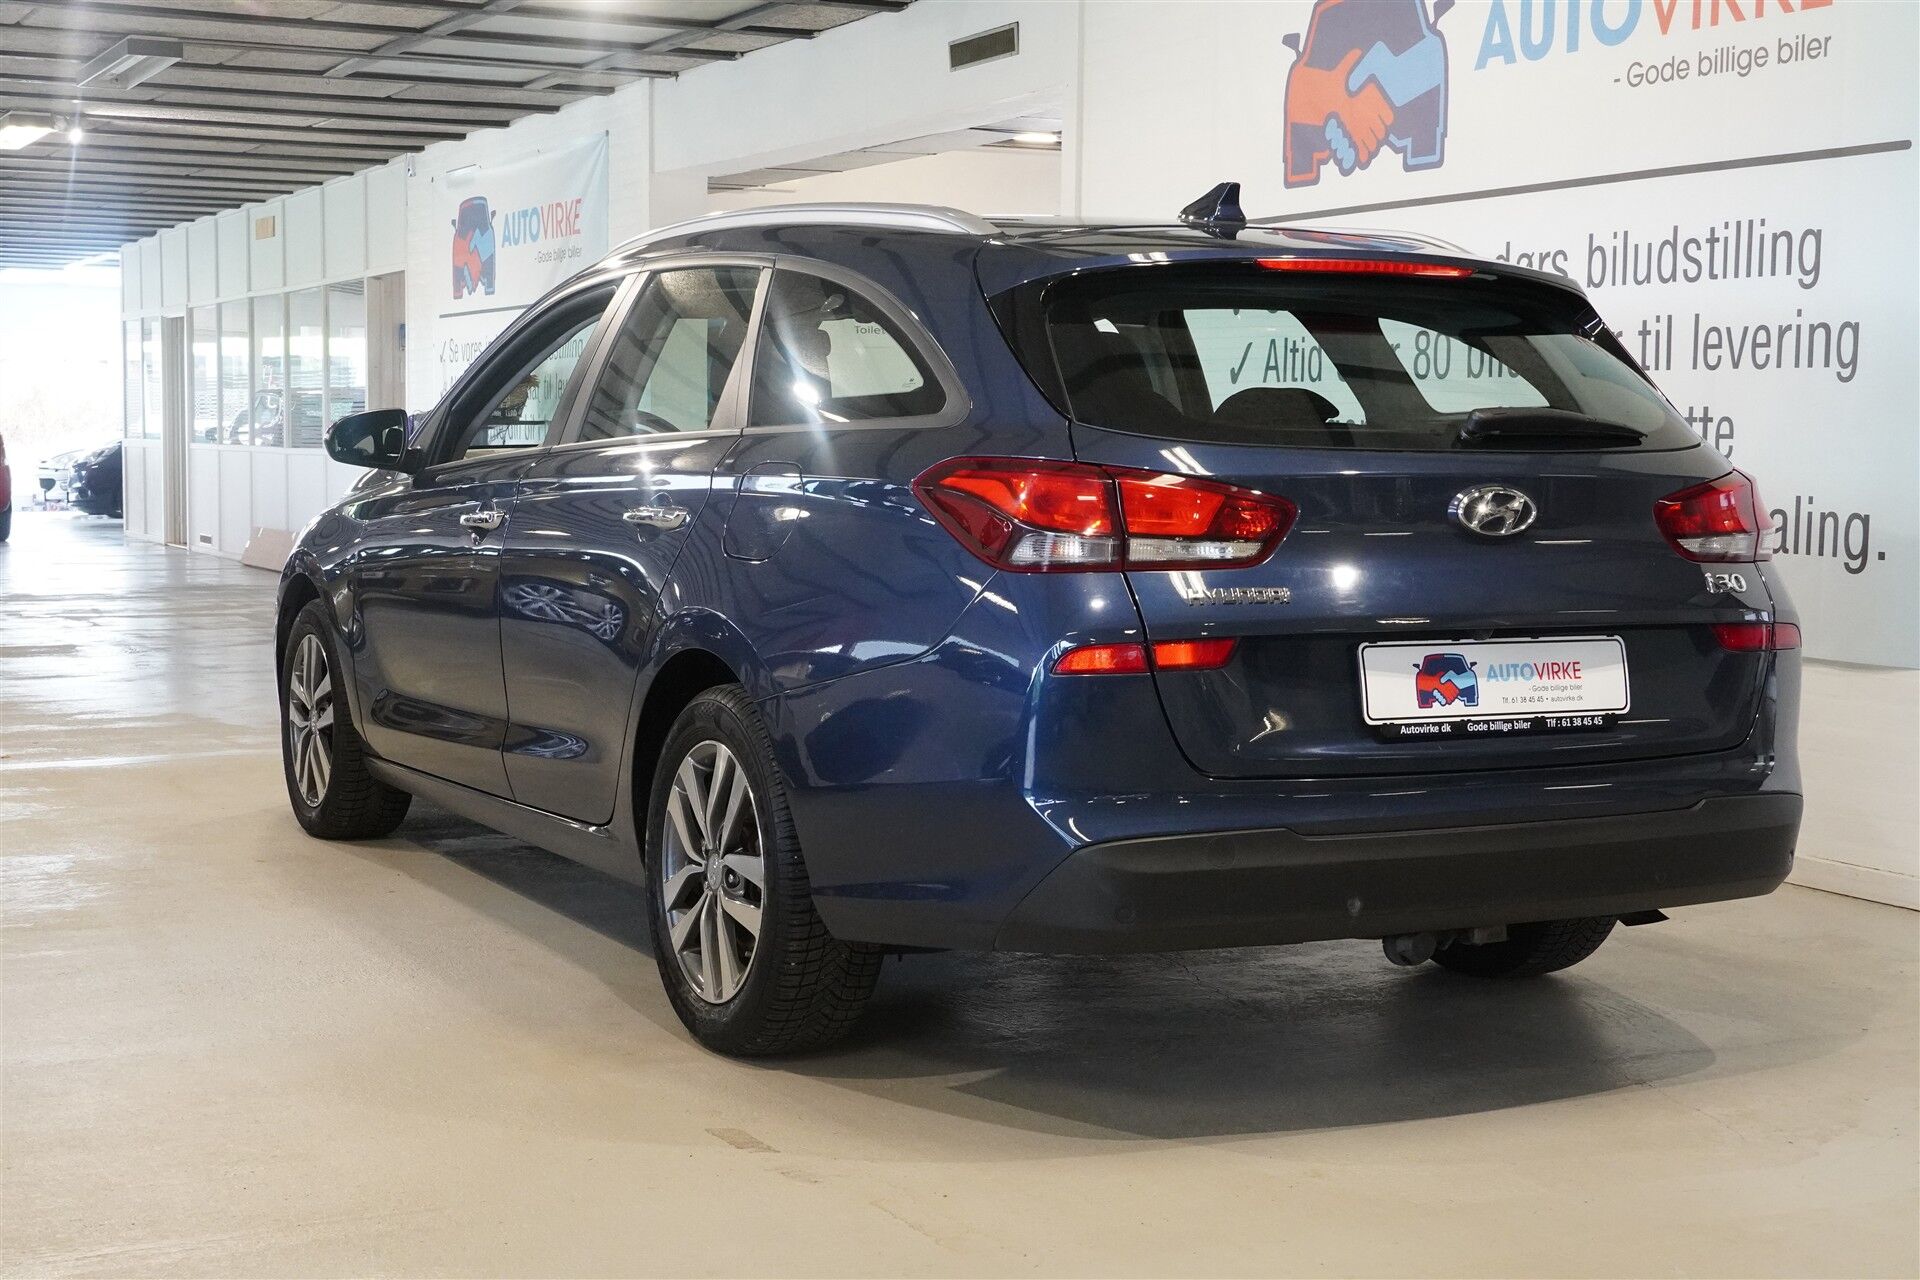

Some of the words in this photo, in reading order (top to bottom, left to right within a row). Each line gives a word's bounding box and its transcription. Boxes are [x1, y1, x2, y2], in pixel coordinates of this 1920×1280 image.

[1626, 55, 1690, 88] Gode
[1697, 46, 1769, 78] billige
[1777, 34, 1832, 65] biler
[501, 198, 582, 248] AUTOVIRKE
[1586, 218, 1823, 289] biludstilling
[1263, 337, 1323, 383] Altid
[1413, 330, 1451, 380] 80
[1637, 314, 1673, 371] til
[1691, 308, 1860, 383] levering
[1770, 495, 1886, 575] aling.
[1704, 572, 1747, 594] i30
[1486, 661, 1582, 683] AUTOVIRKE
[1531, 684, 1549, 692] Gode
[1511, 696, 1518, 704] 61
[1536, 695, 1545, 703] 45
[1400, 723, 1440, 735] Autovirke
[1467, 722, 1488, 732] Gode
[1489, 720, 1513, 733] billige
[1514, 719, 1531, 730] biler
[1561, 717, 1571, 727] 61
[1572, 717, 1582, 727] 38
[1582, 716, 1592, 726] 45
[1593, 716, 1603, 725] 45
